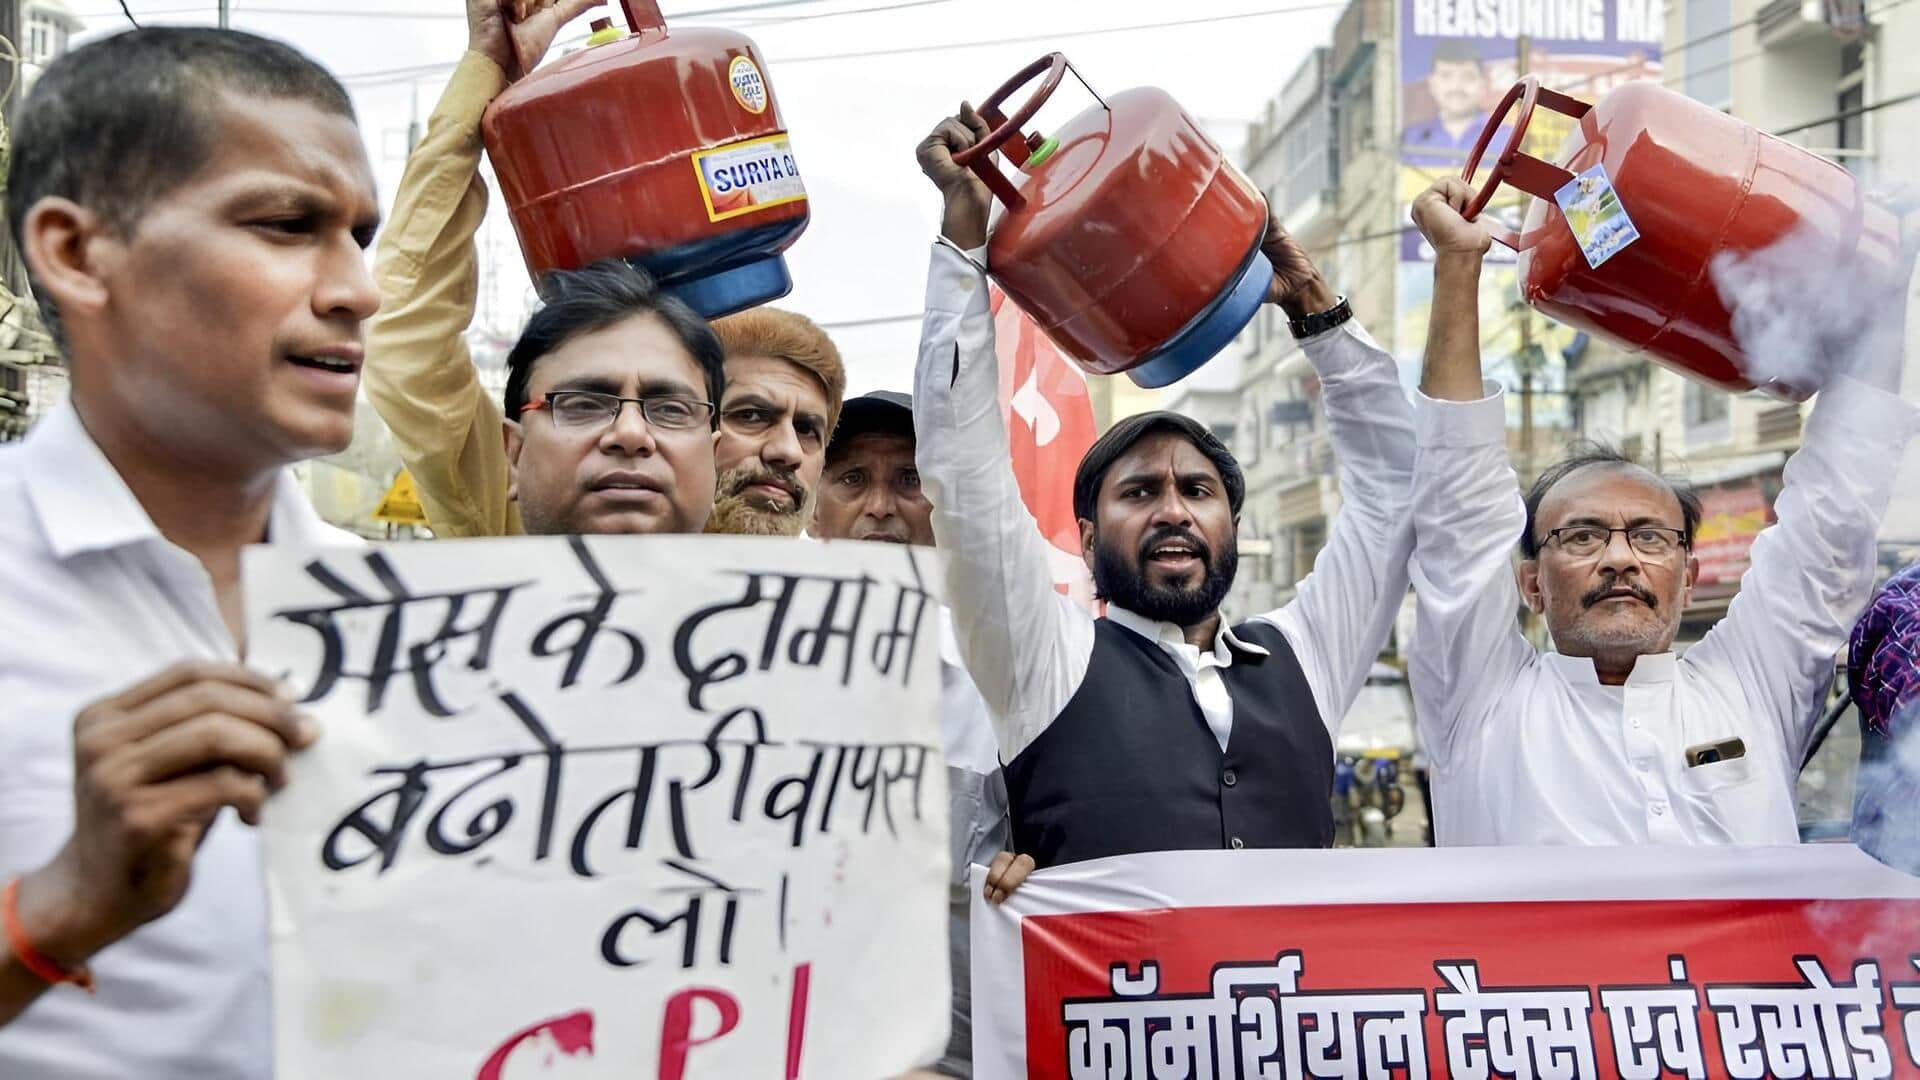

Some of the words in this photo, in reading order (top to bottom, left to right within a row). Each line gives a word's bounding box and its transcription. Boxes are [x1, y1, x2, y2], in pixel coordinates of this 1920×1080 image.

[1413, 0, 1605, 41] REASONING
[713, 157, 784, 192] SURYA
[529, 535, 647, 690] के
[674, 572, 880, 712] दाम
[764, 740, 938, 848] वापस
[1434, 959, 1596, 1080] टैक्स
[1600, 955, 1714, 1080] एवं
